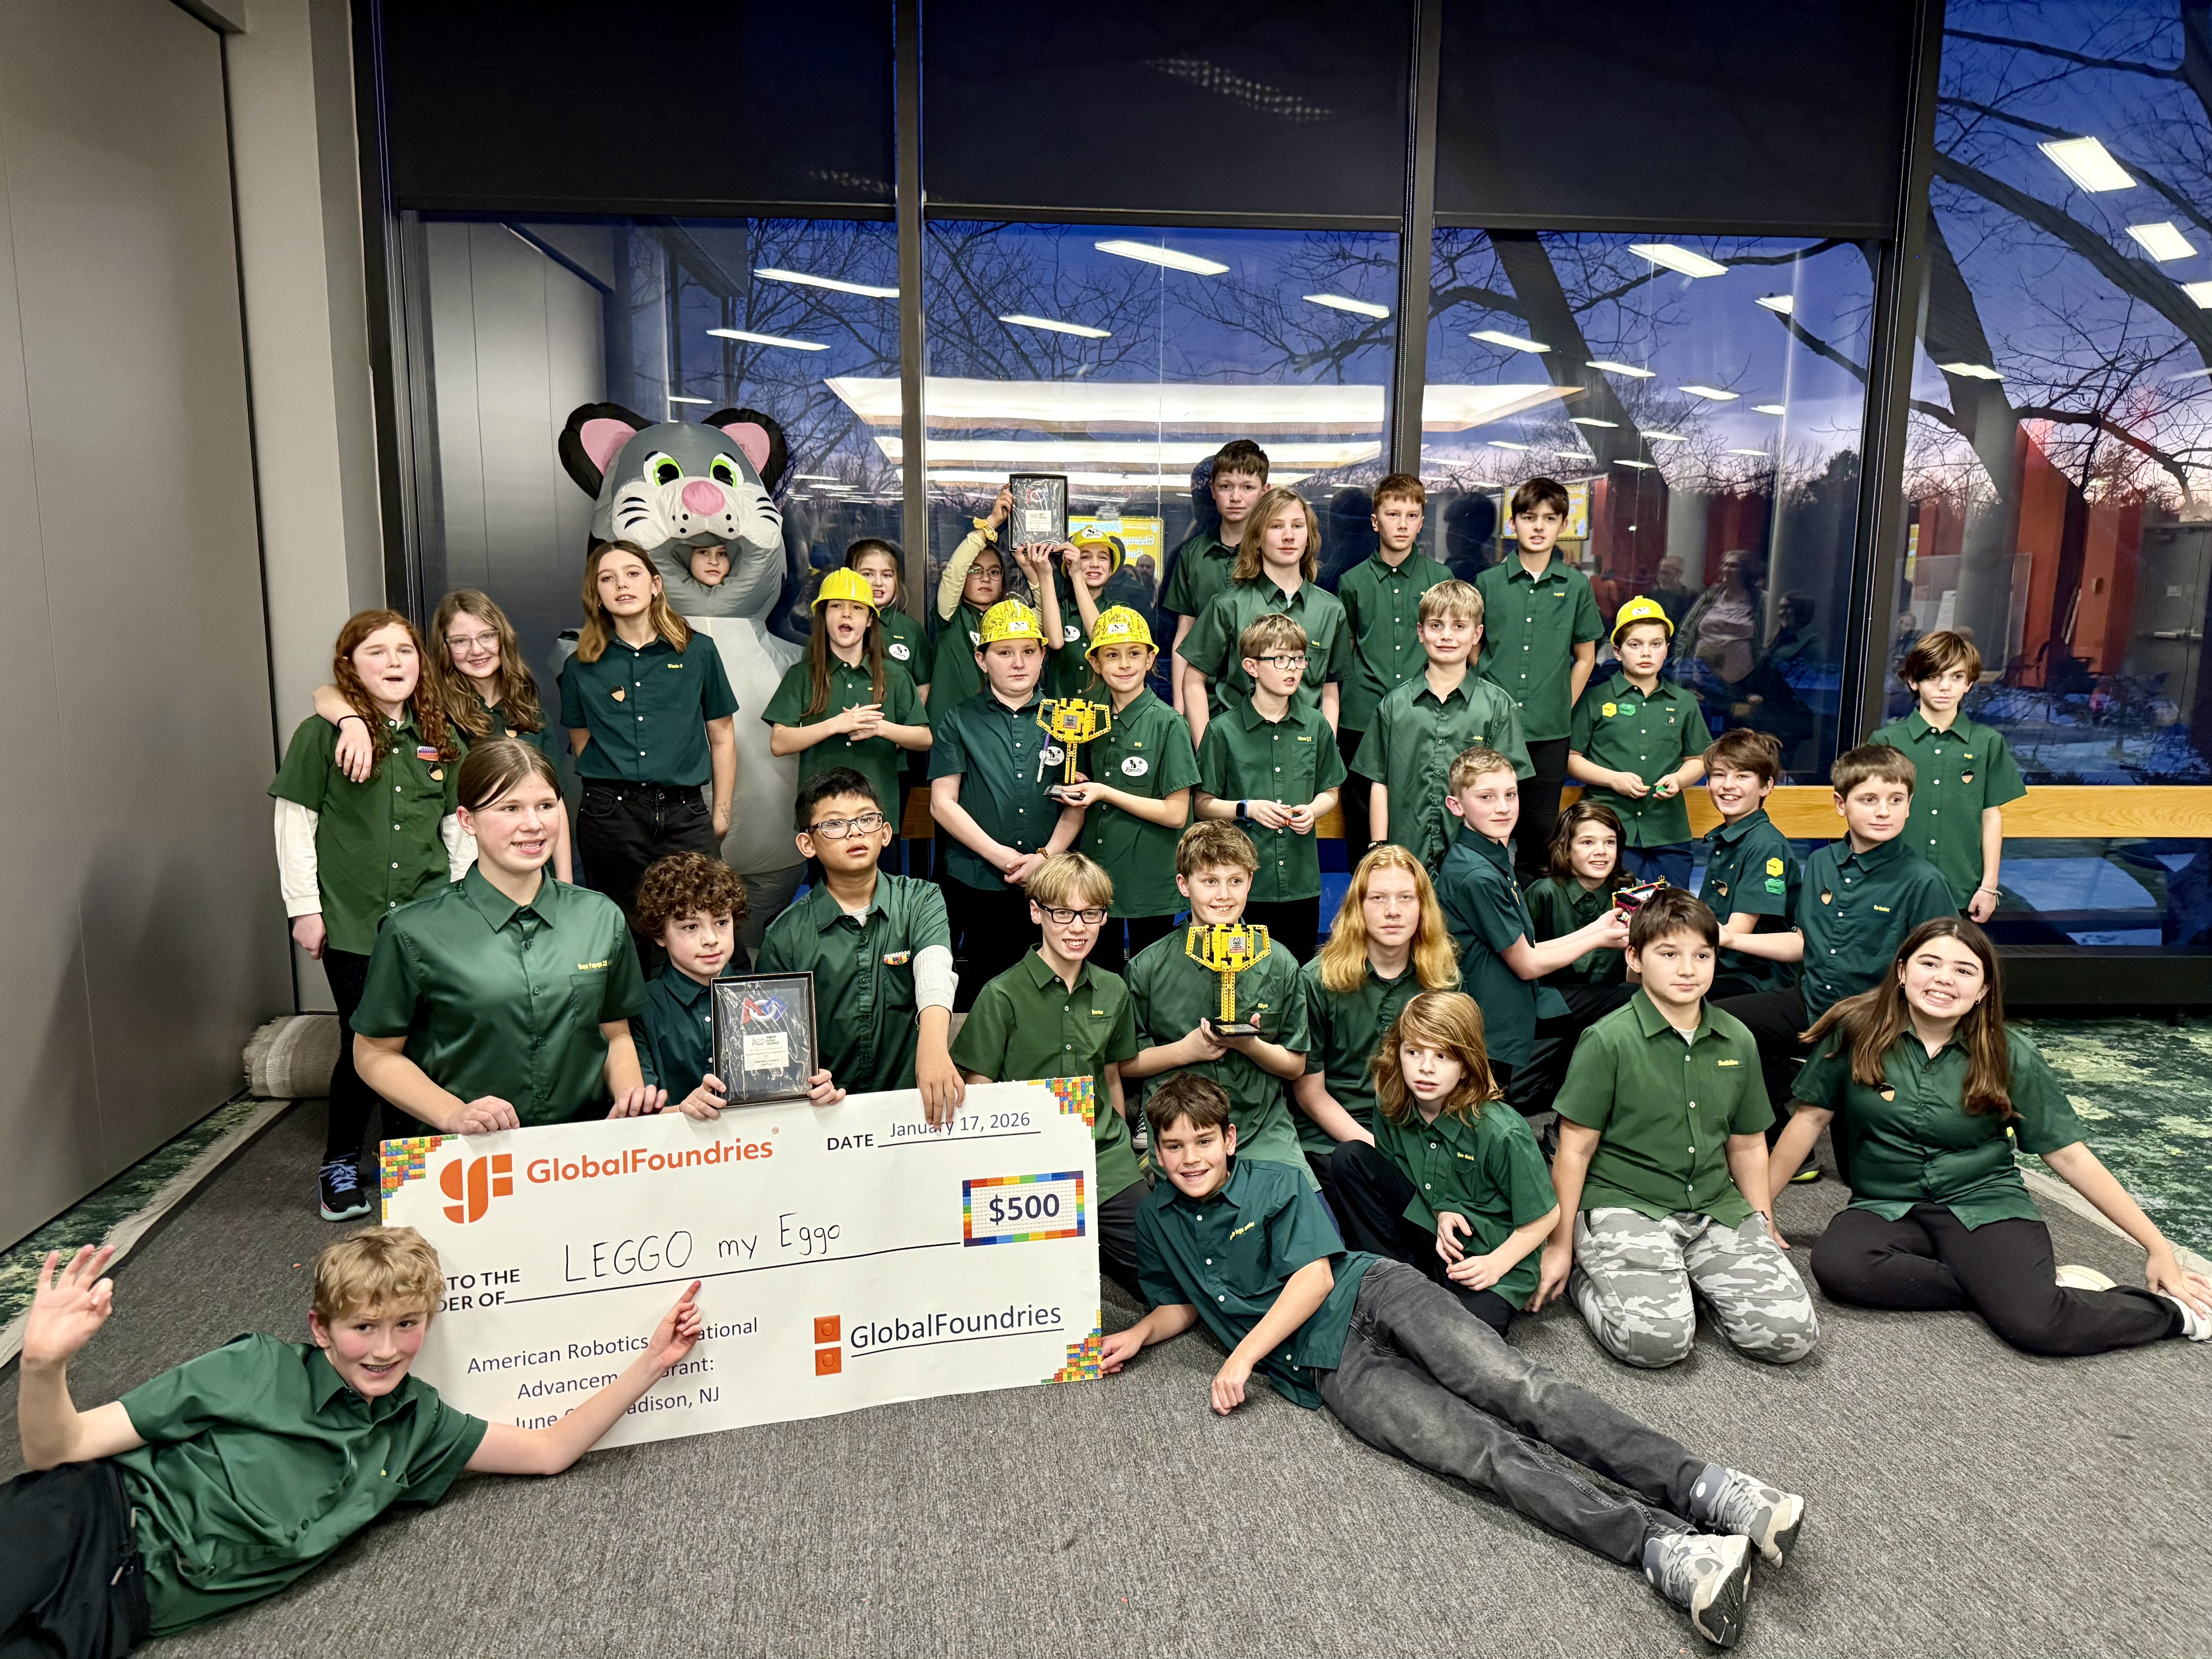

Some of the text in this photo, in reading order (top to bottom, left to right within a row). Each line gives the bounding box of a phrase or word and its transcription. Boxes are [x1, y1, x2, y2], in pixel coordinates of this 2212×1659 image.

[827, 1134, 874, 1151] DATE
[960, 1116, 984, 1132] 17,
[991, 1112, 1030, 1128] 2026
[989, 1194, 1060, 1225] $500
[565, 1212, 840, 1282] LEGGO my Eggo
[447, 1269, 520, 1290] TO THE
[437, 1291, 505, 1312] DER OF
[850, 1304, 1061, 1348] GlobalFoundries
[467, 1317, 757, 1374] American Robotics ational
[518, 1373, 618, 1399] Advancem
[627, 1394, 692, 1414] adison,
[700, 1387, 719, 1404] NJ
